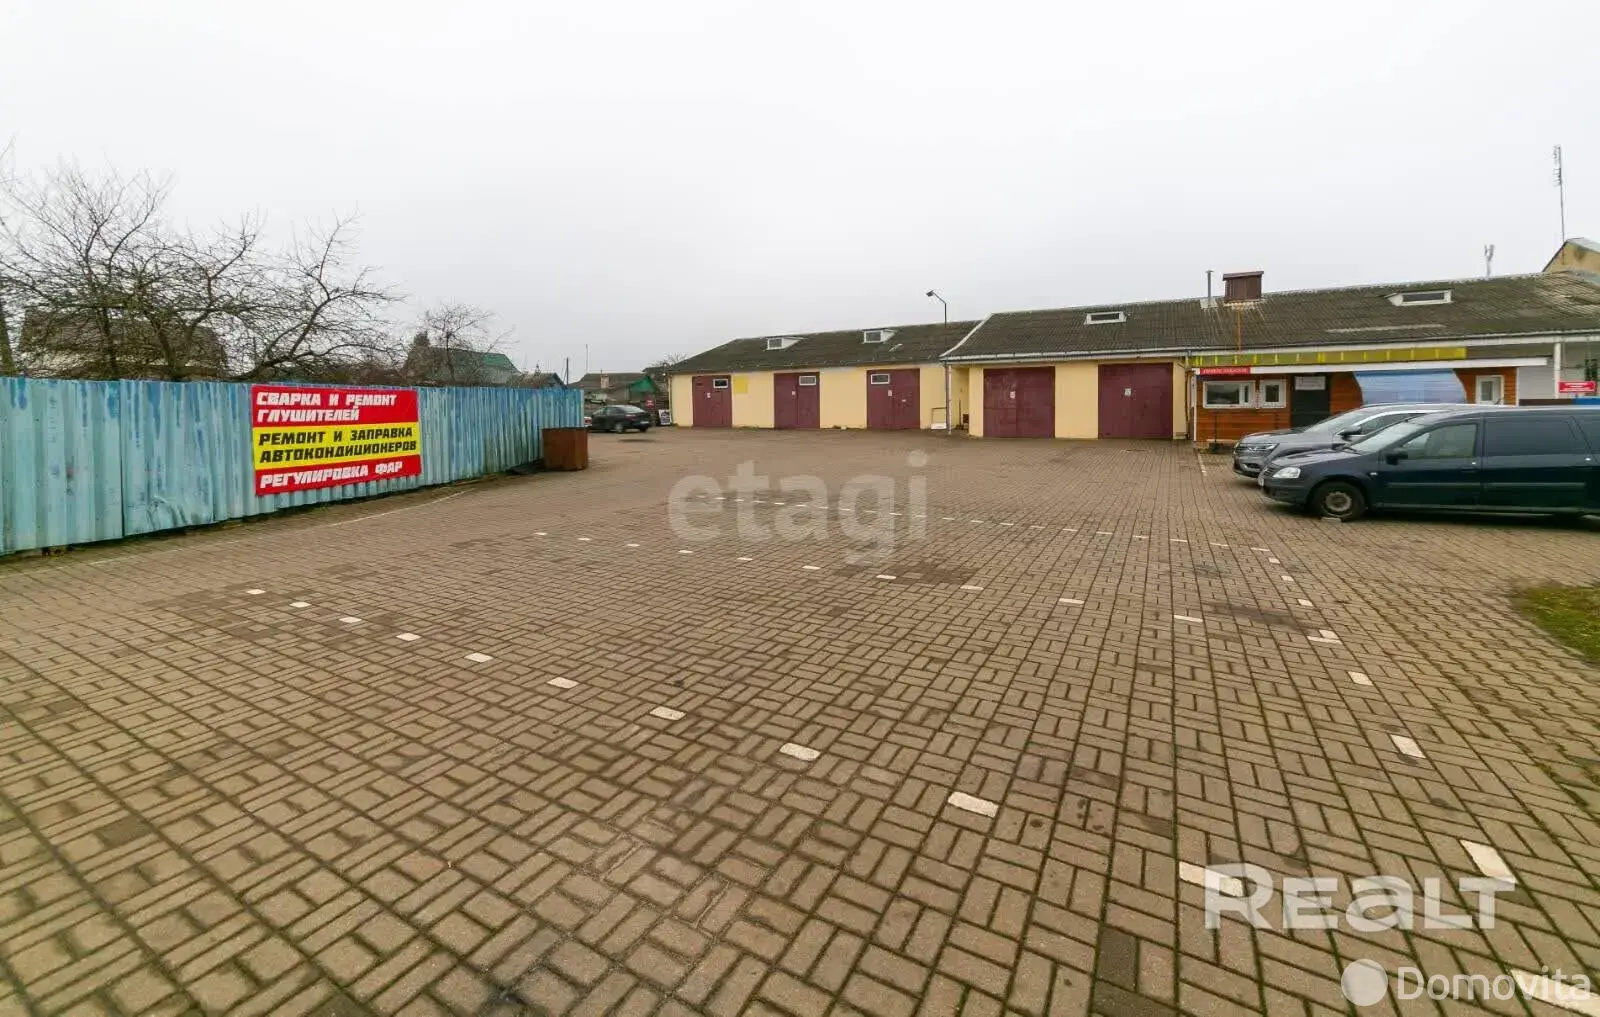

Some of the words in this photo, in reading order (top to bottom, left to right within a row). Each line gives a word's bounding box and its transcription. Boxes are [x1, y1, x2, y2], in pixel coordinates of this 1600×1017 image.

[256, 392, 321, 406] СВАРКА
[328, 394, 339, 406] И
[345, 394, 397, 406] РЕМОНТ
[257, 406, 360, 422] ГЛУШИТЕЛЕЙ
[259, 431, 326, 446] РЕМОНТ
[333, 431, 343, 442] И
[350, 427, 412, 441] ЗАПРАВКА
[259, 441, 417, 463] АВТОКОНДИЦИОНЕРОВ
[260, 465, 369, 489] РЕГУЛИРОВКА
[375, 461, 403, 475] ФАР
